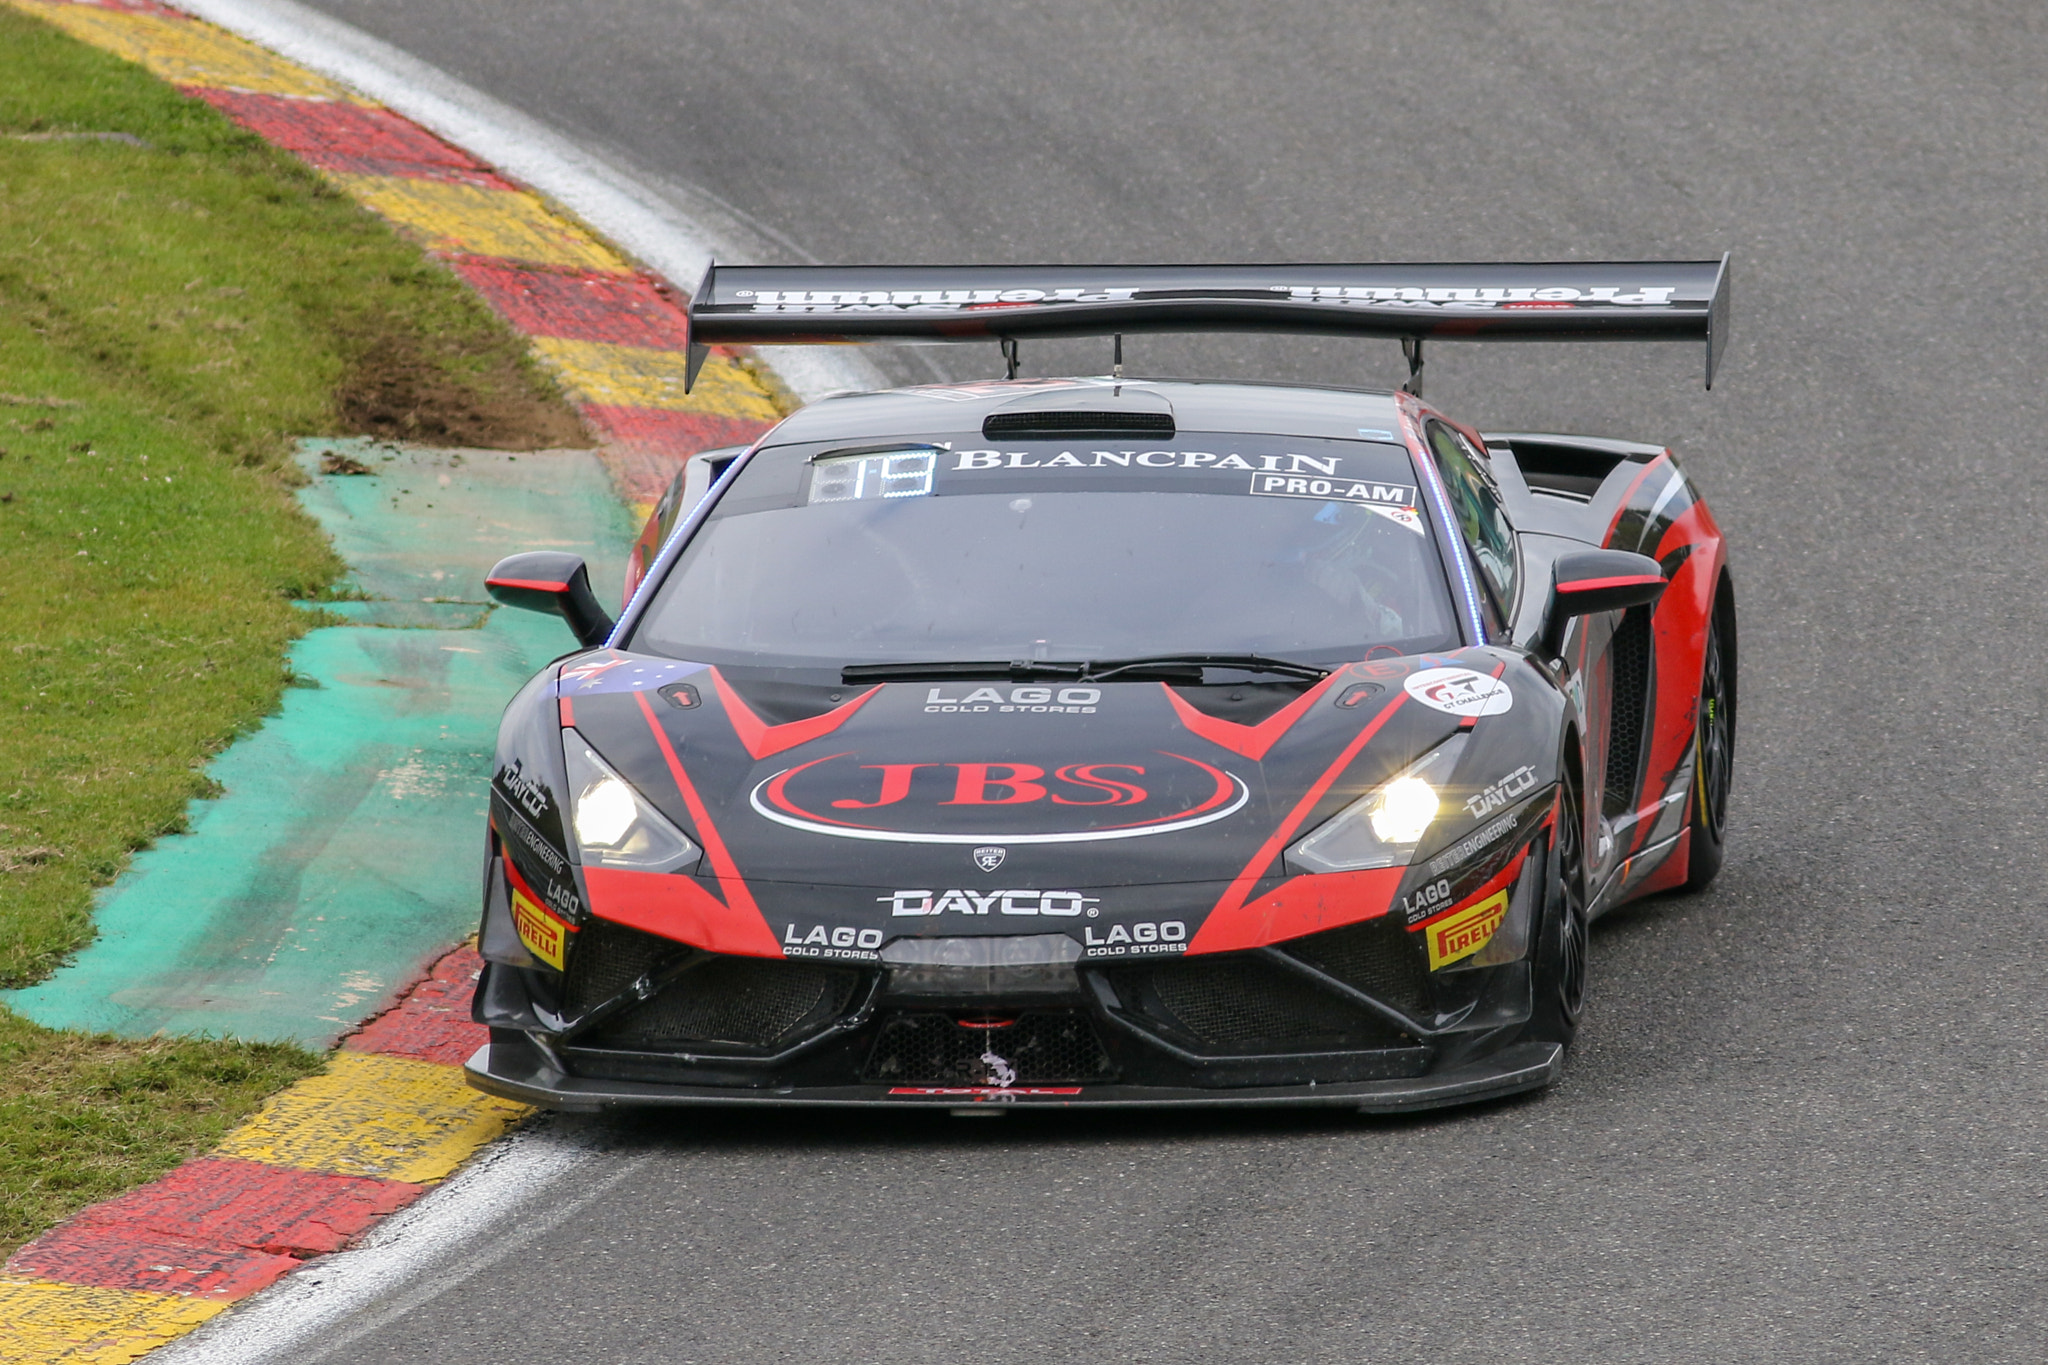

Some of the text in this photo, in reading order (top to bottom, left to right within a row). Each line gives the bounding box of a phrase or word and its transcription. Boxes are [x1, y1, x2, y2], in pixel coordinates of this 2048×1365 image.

[951, 449, 1343, 476] BLANCPAIN
[1263, 477, 1404, 502] PRO-AM
[924, 705, 1097, 714] COLD STORES
[925, 688, 1101, 704] LAGO
[830, 763, 1148, 809] JBS
[1464, 765, 1538, 819] DAYCO
[546, 878, 580, 915] LAGO
[890, 889, 1085, 916] DAYCO
[1402, 878, 1451, 915] LAGO
[1407, 897, 1454, 925] COLD STORES
[515, 901, 557, 958] PIRELLI
[785, 923, 883, 949] LAGO
[1085, 920, 1186, 946] LAGO
[783, 946, 820, 956] COLD
[1087, 943, 1187, 956] COLD STORES
